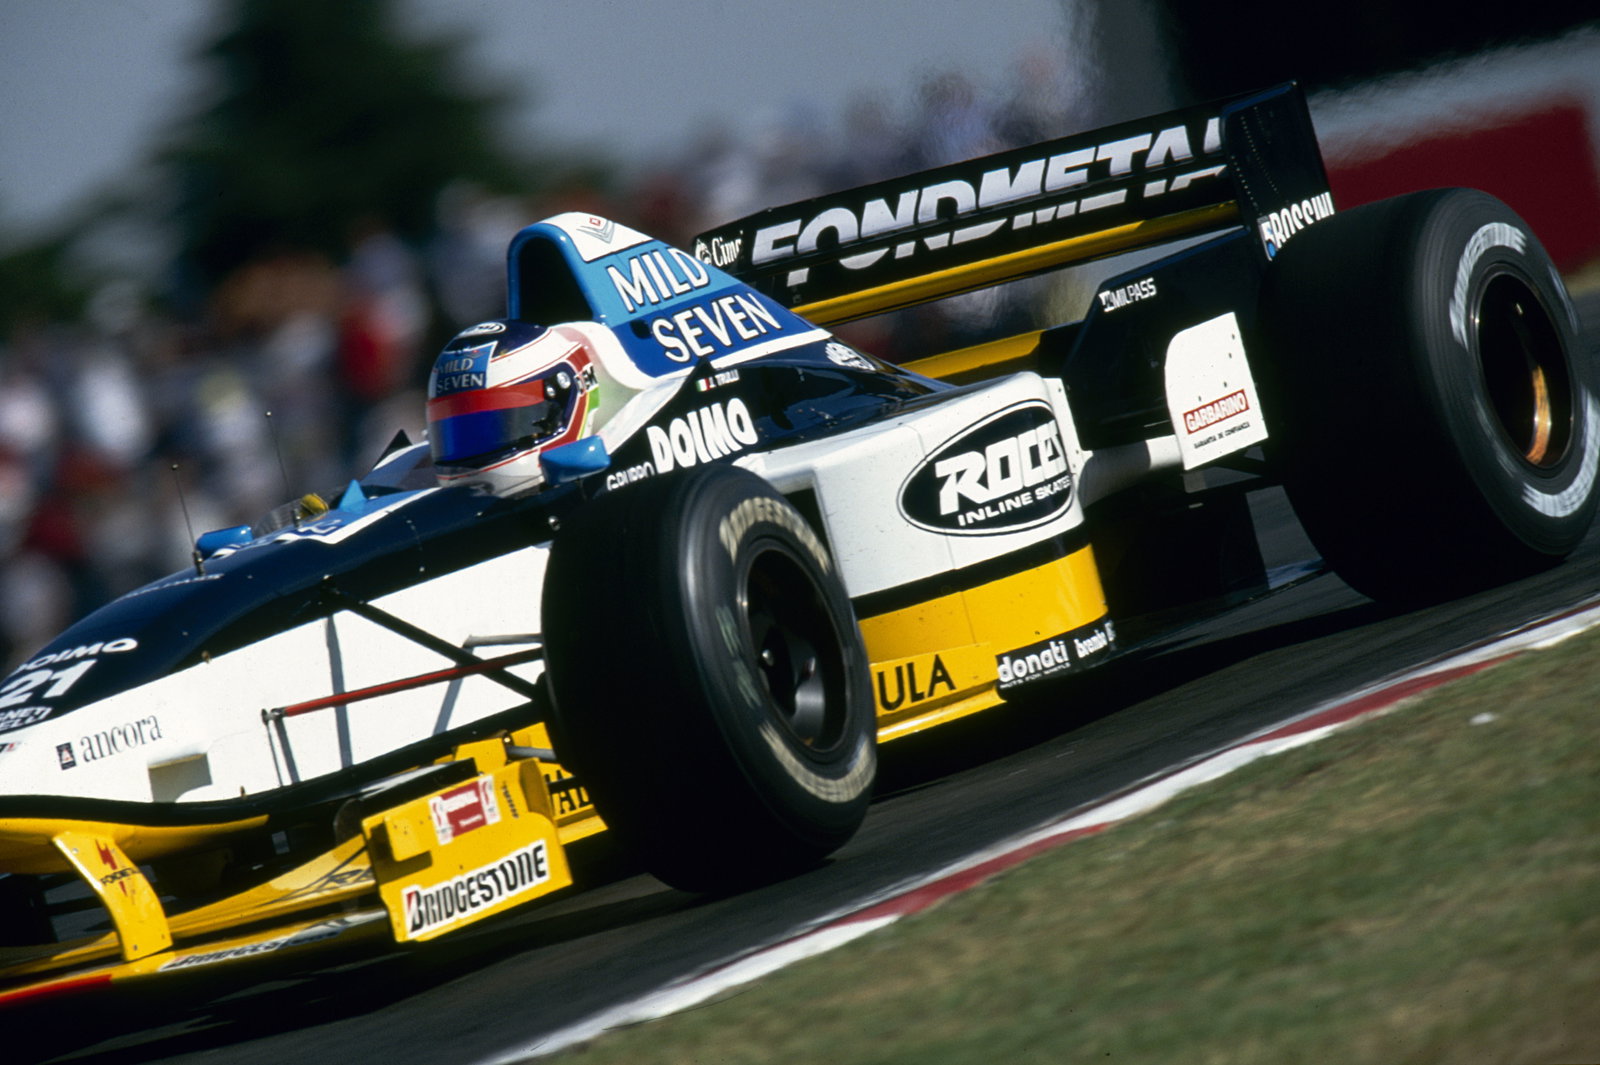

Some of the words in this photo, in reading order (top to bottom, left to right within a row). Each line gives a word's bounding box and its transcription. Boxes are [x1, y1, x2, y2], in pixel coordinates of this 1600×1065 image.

[750, 116, 1228, 287] FONDMETAL
[607, 247, 710, 313] MILD
[652, 292, 782, 363] SEVEN
[436, 372, 484, 394] SEVEN
[646, 397, 758, 474] DOIMO
[1186, 391, 1248, 432] GARBARINO
[957, 491, 1034, 527] INLINE
[0, 659, 97, 709] 21
[997, 640, 1069, 683] donati
[79, 715, 163, 763] ancora
[405, 844, 547, 933] BRIDGESTONE
